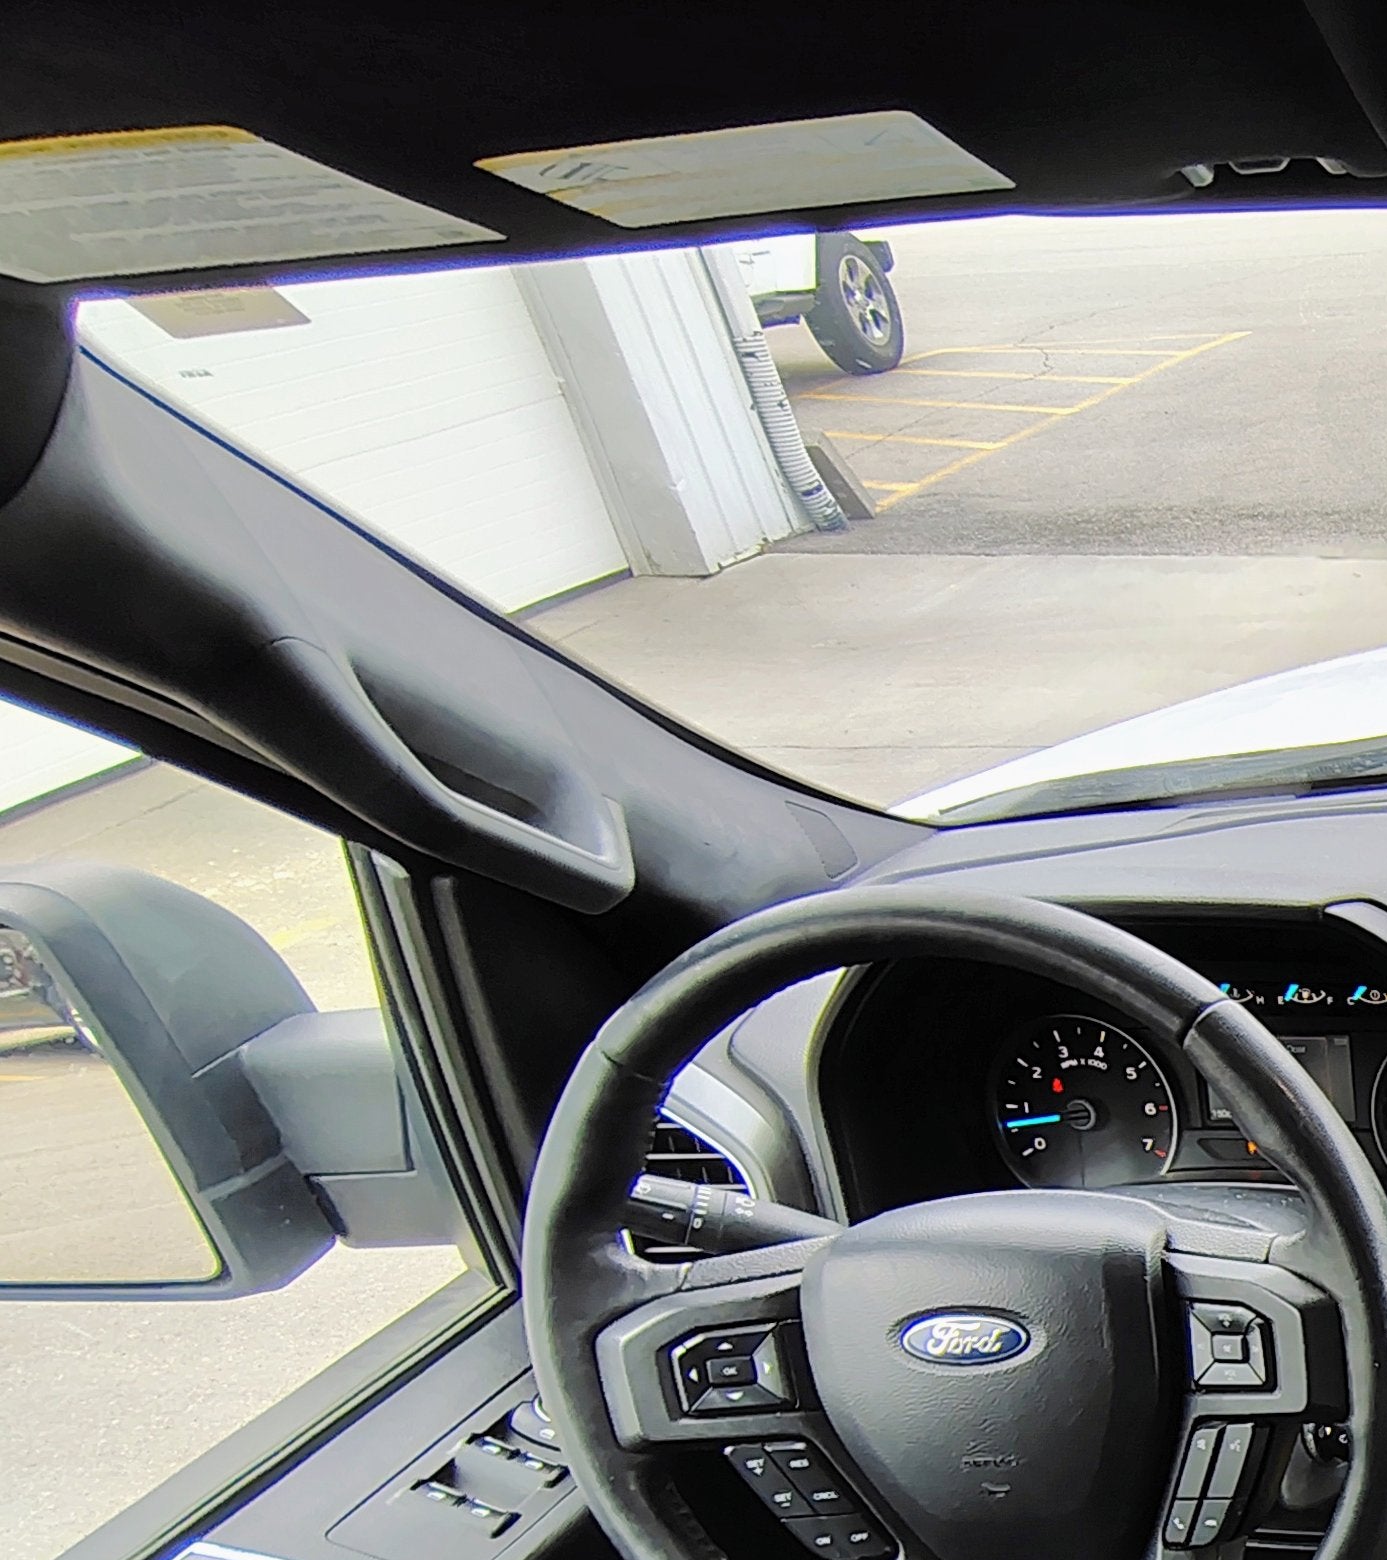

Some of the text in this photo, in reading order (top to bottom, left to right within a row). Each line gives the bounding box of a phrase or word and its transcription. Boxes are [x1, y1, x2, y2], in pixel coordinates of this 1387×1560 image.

[1058, 1046, 1069, 1058] 3
[1094, 1046, 1104, 1058] 4
[1088, 1058, 1108, 1071] 1000
[1032, 1066, 1042, 1079] 2
[1126, 1067, 1137, 1080] 5
[1024, 1102, 1029, 1113] 1
[1144, 1102, 1157, 1115] 6
[1034, 1137, 1047, 1150] 0
[1142, 1138, 1153, 1150] 7
[927, 1321, 1011, 1357] Ford
[722, 1366, 738, 1376] OK
